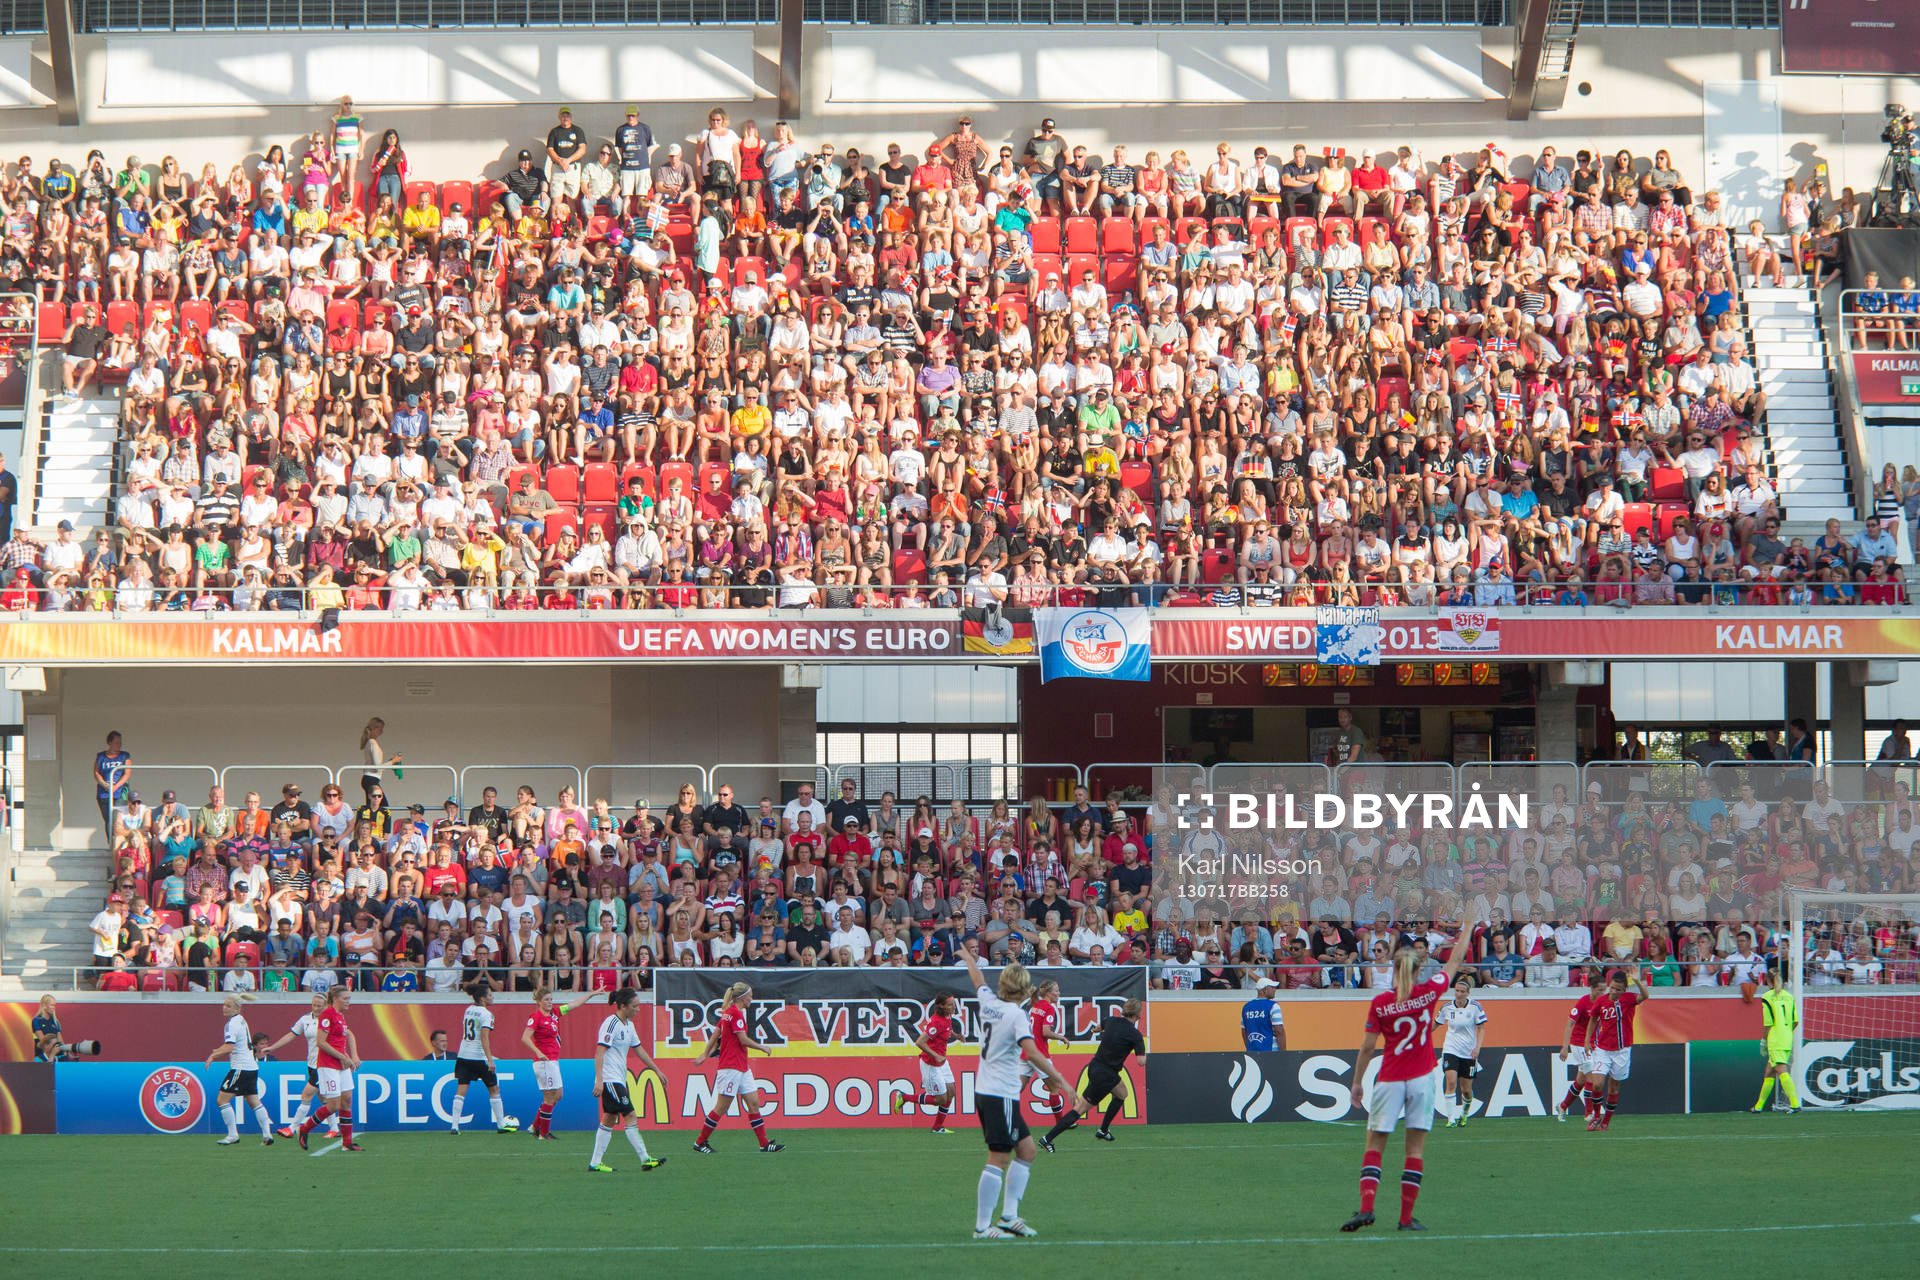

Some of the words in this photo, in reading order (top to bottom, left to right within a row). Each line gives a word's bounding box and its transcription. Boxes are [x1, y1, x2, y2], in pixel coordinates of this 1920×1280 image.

[1872, 359, 1920, 371] KALMA
[212, 627, 342, 653] KALMAR
[618, 628, 703, 650] UEFA
[710, 628, 856, 650] WOMEN'S
[865, 628, 950, 650] EURO
[1226, 626, 1317, 649] SWED
[1377, 626, 1439, 649] 2013
[1716, 624, 1843, 648] KALMAR
[1164, 663, 1247, 684] KIOSK
[665, 999, 788, 1047] PSK
[1246, 1010, 1265, 1019] 1524
[1603, 1006, 1616, 1020] 22
[464, 1018, 475, 1041] 13
[1394, 1008, 1430, 1056] 21
[151, 1071, 191, 1085] UEFA
[326, 1080, 337, 1092] 19
[726, 1081, 734, 1094] 8
